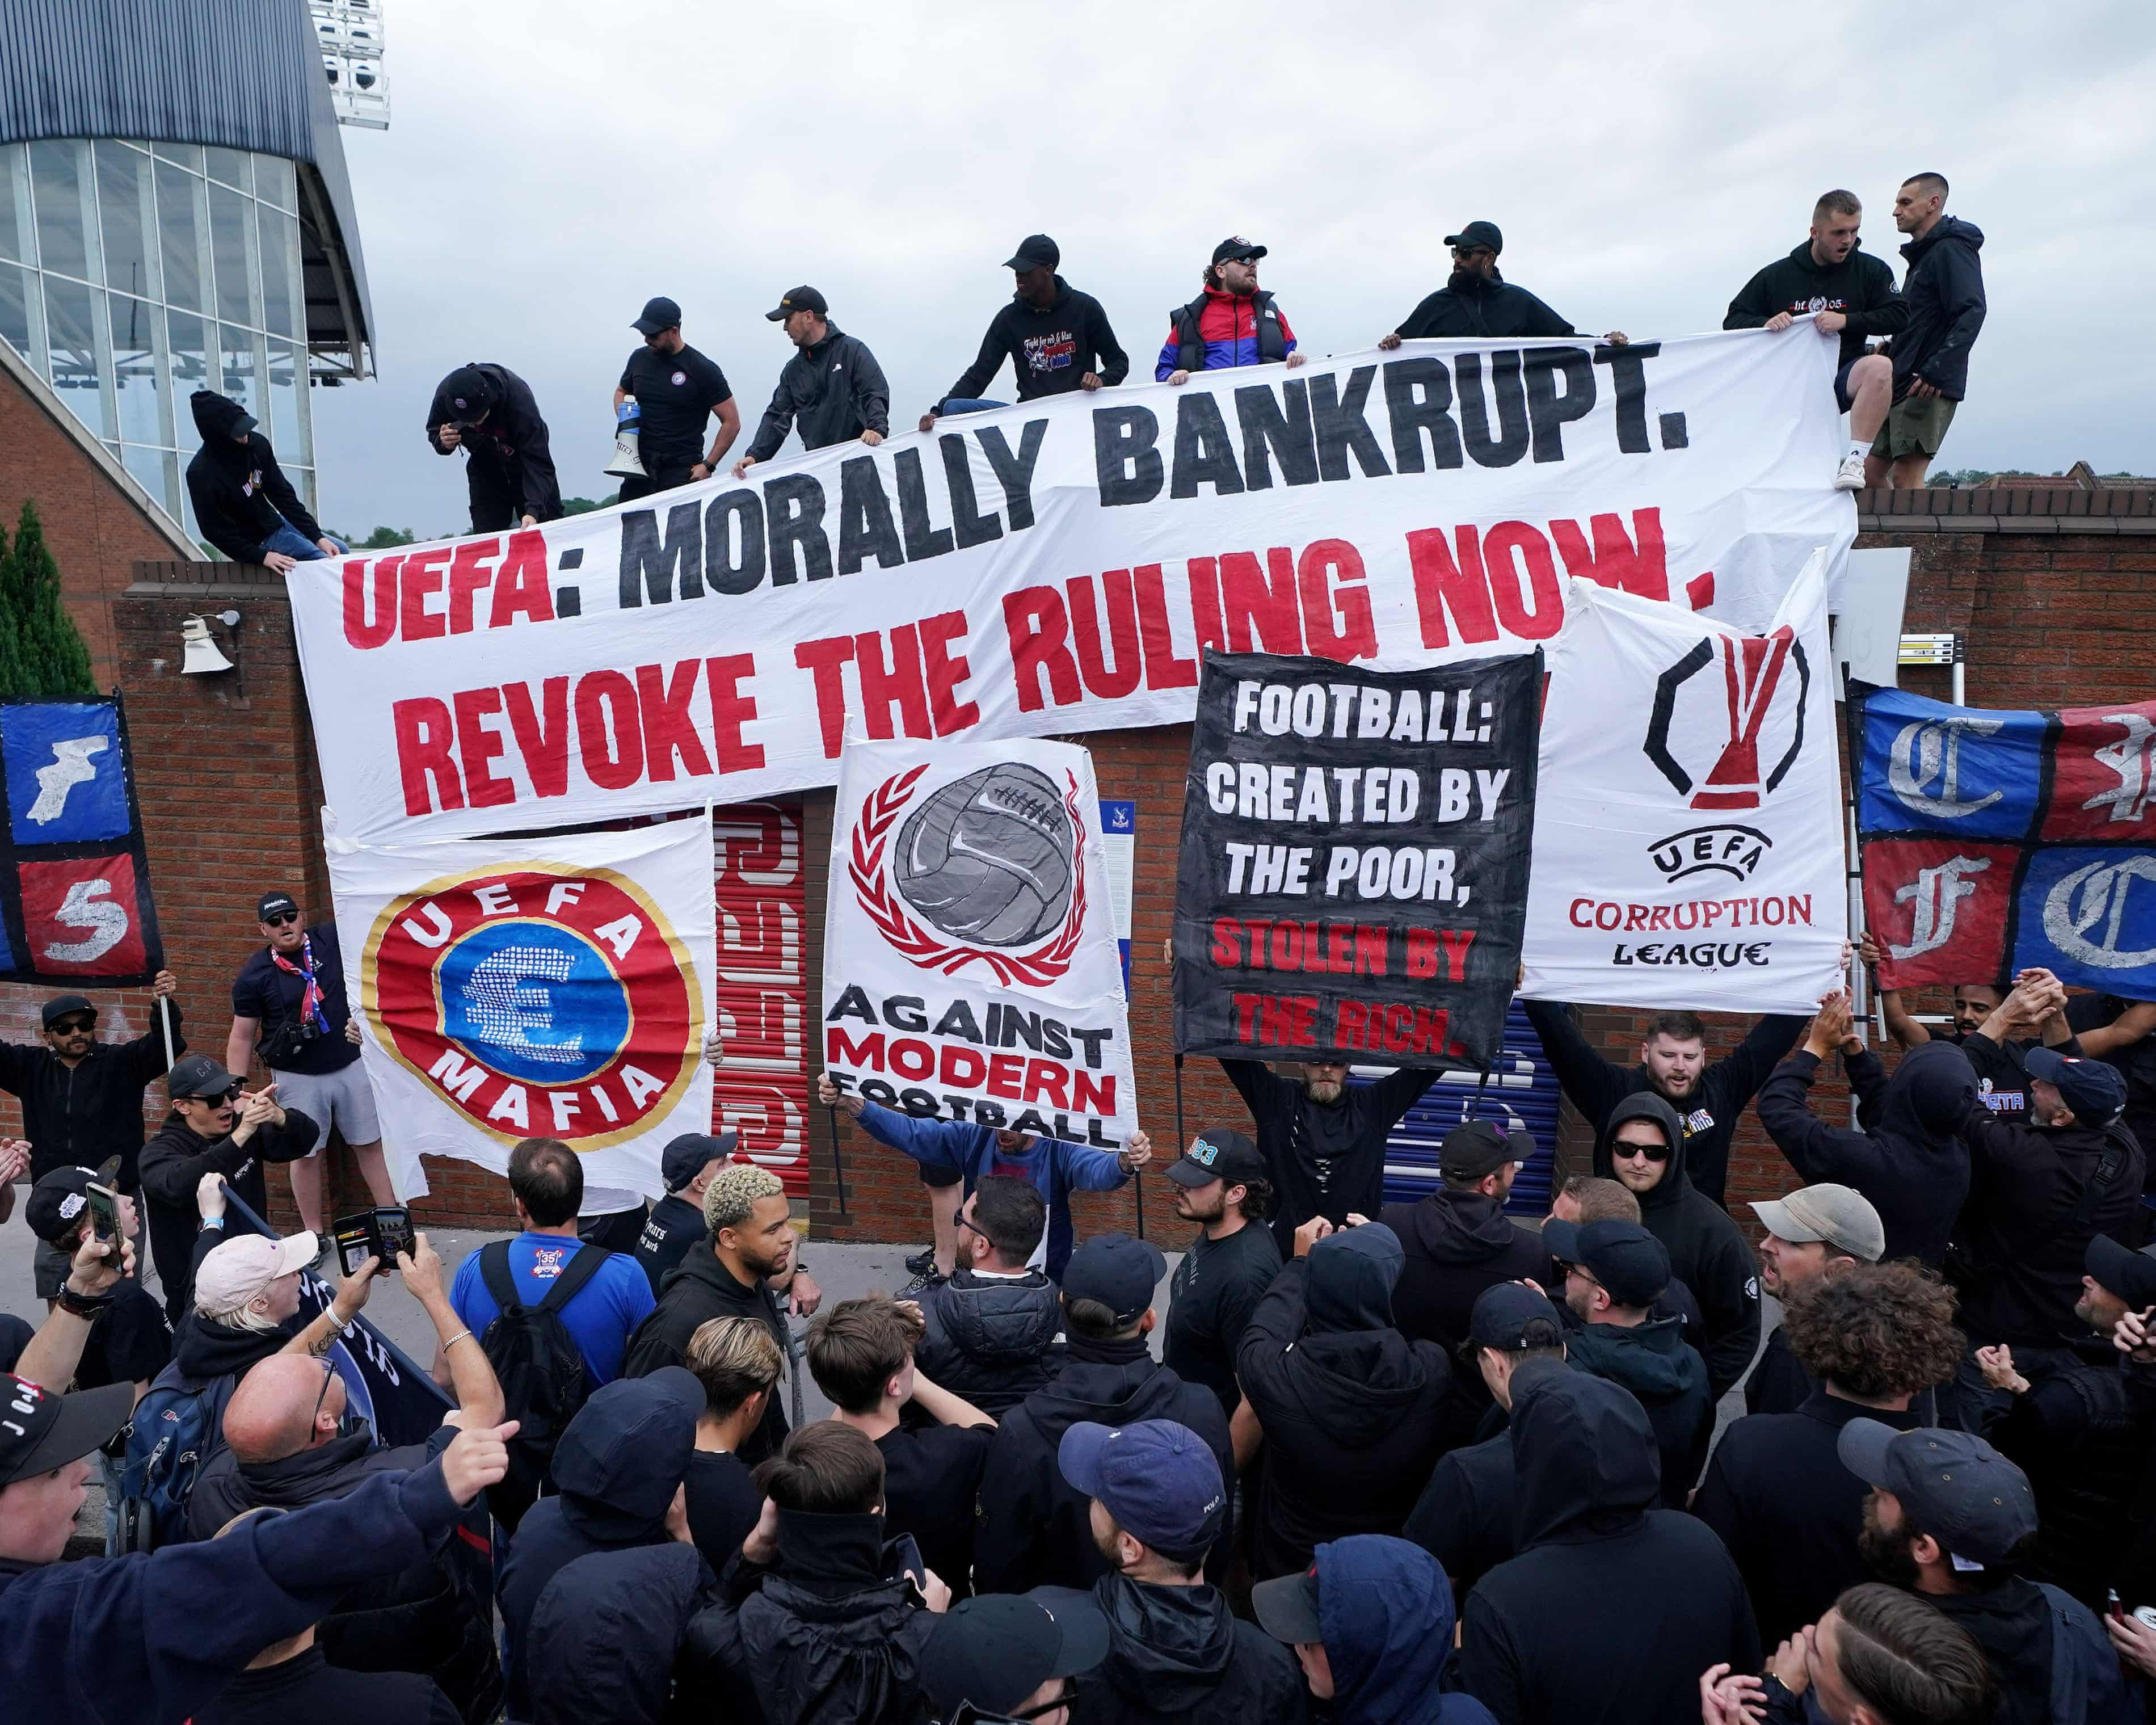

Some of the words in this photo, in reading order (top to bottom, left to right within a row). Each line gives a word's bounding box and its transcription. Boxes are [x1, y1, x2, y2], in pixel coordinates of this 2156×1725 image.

[342, 529, 584, 649] UEFA:
[620, 418, 1050, 608] MORALLY
[1092, 342, 1689, 507] BANKRUPT.
[393, 653, 766, 817] REVOKE
[794, 609, 980, 759] THE
[1001, 537, 1379, 706] RULING
[1405, 507, 1716, 650] NOW.
[1233, 680, 1492, 743] FOOTBALL:
[1206, 762, 1420, 823] CREATED
[1438, 767, 1511, 822] BY
[1226, 842, 1313, 895] THE
[1325, 847, 1471, 909] POOR,
[1653, 835, 1762, 874] UEFA
[401, 883, 645, 961] UEFA
[1569, 894, 1813, 932] CORRUPTION
[1210, 918, 1389, 977] STOLEN
[1407, 927, 1476, 983] BY
[826, 983, 1113, 1069] AGAINST
[1232, 993, 1319, 1047] THE
[1334, 999, 1467, 1057] RICH.
[428, 1049, 667, 1133] MAFIA
[826, 1027, 1118, 1117] MODERN
[829, 1071, 1121, 1150] FOOTBALL
[1203, 1495, 1220, 1514] POLO
